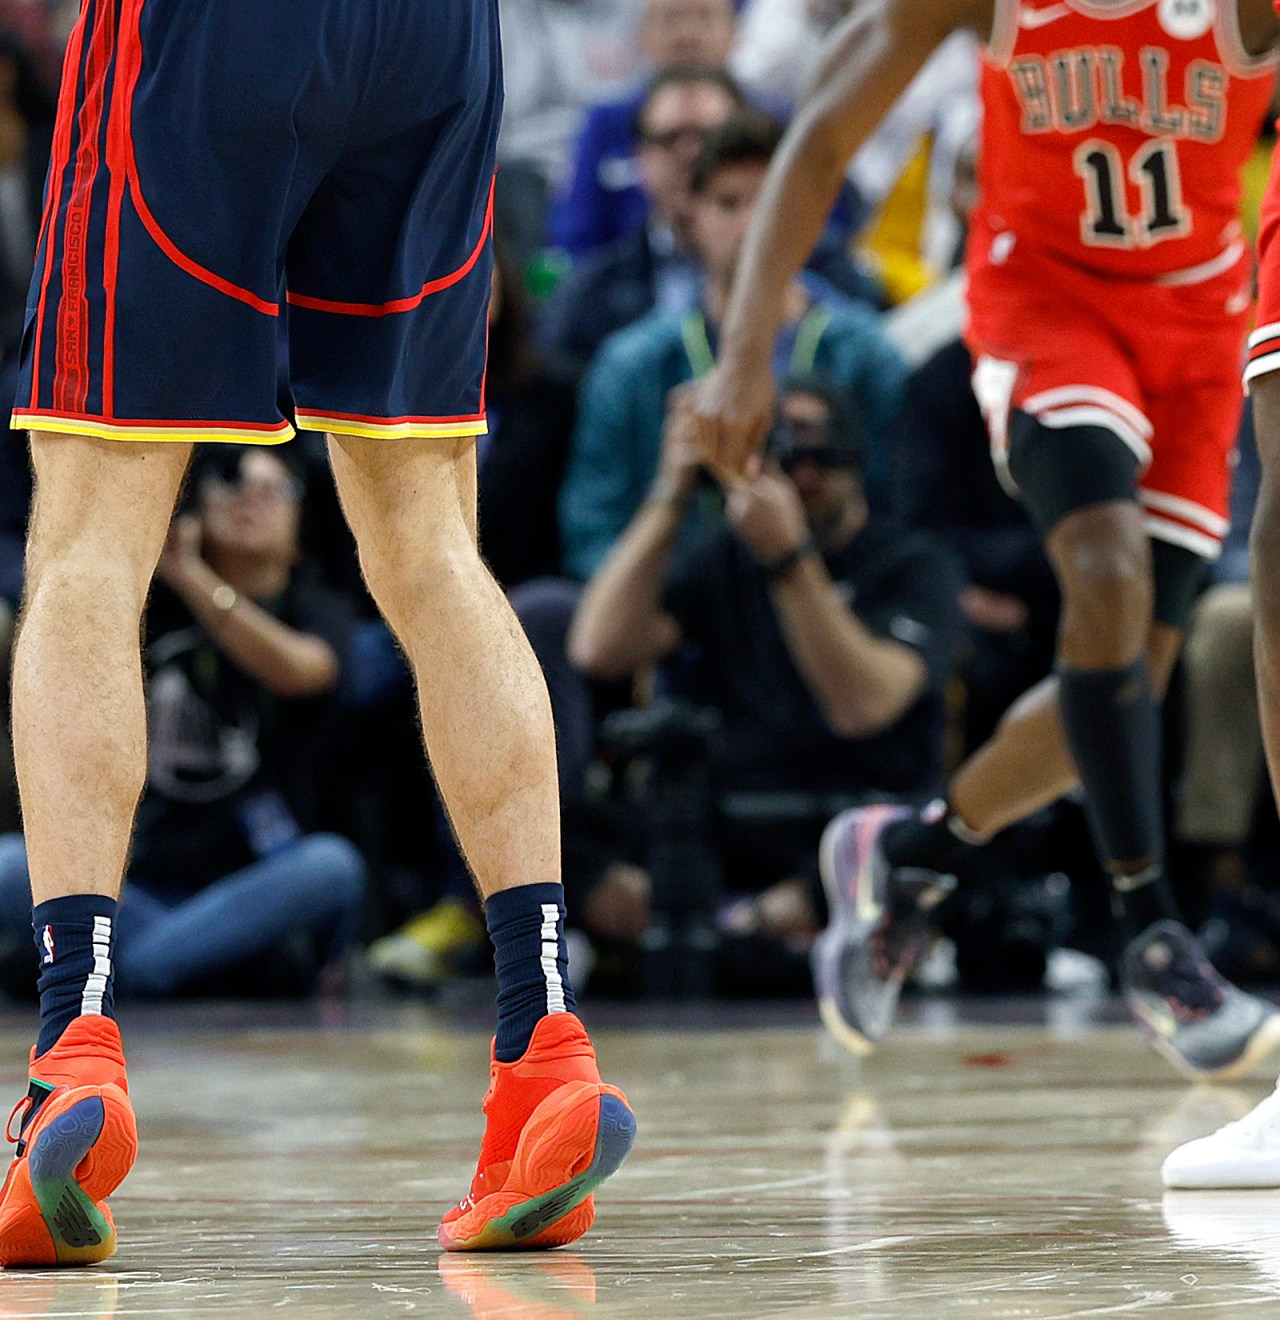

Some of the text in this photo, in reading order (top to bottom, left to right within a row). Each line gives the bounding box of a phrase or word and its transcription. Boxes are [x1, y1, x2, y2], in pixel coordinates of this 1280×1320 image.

[1008, 44, 1228, 145] BULLS
[1073, 138, 1193, 250] 11
[65, 211, 83, 365] SAN FRANCISCO
